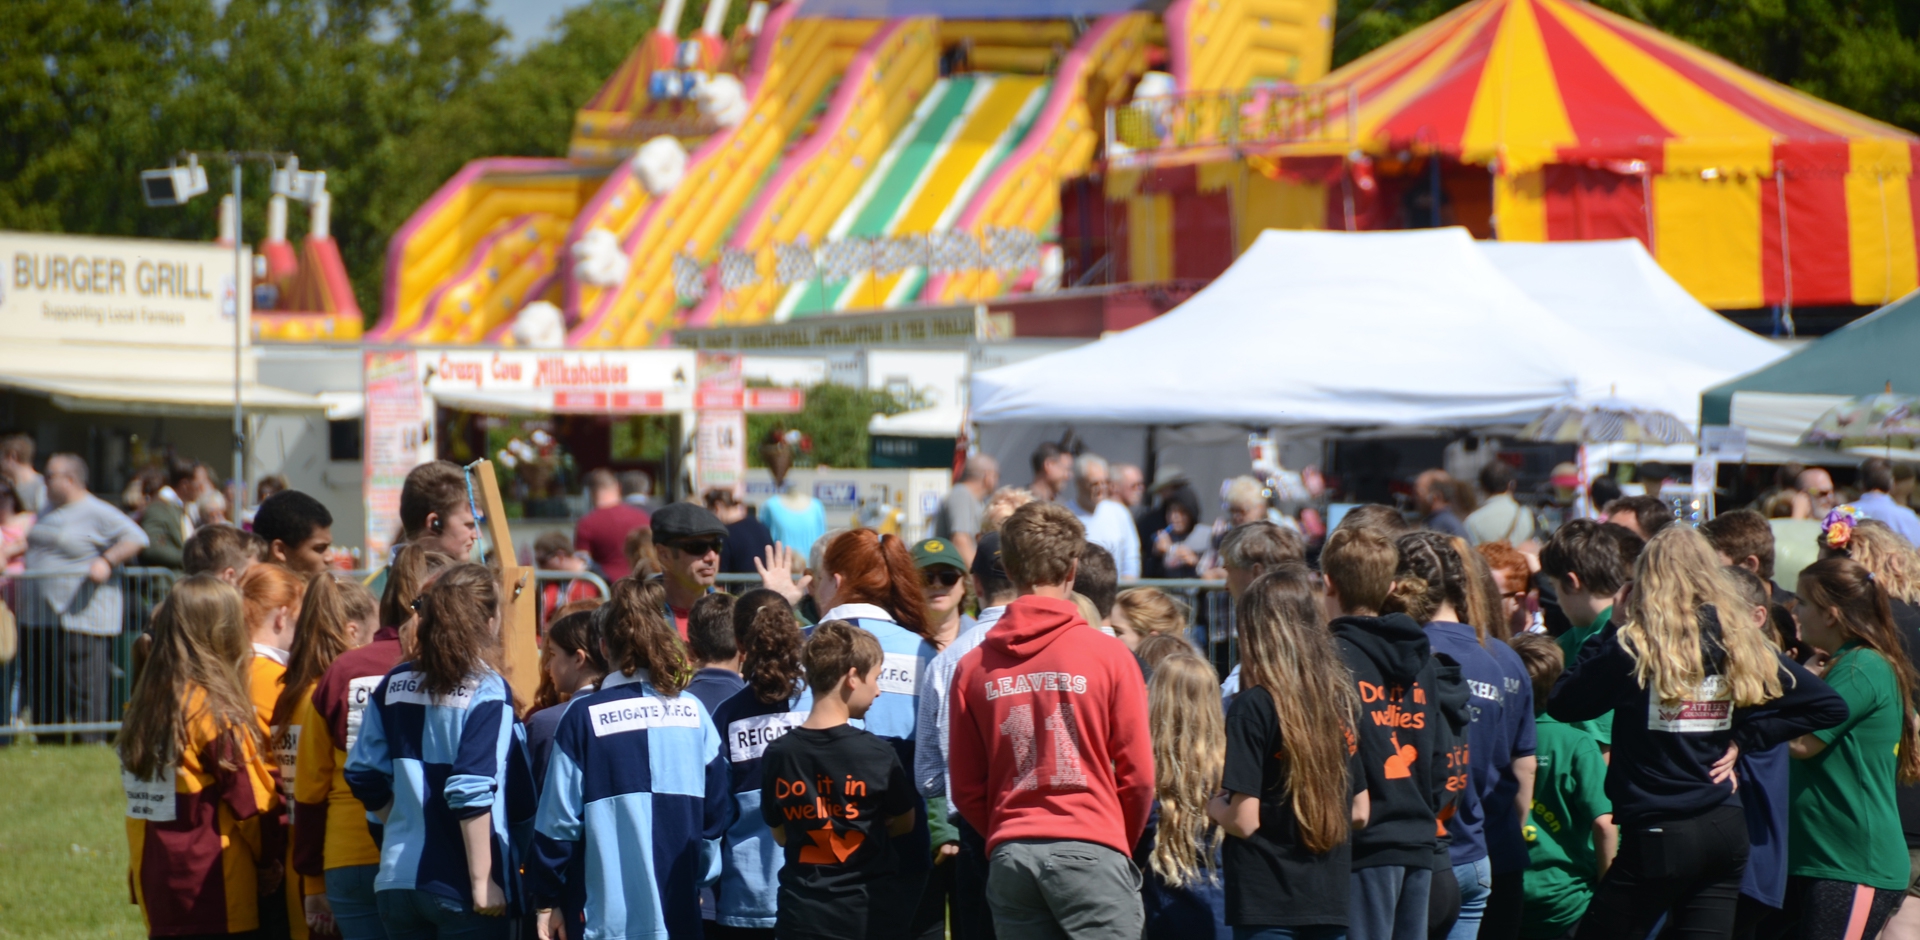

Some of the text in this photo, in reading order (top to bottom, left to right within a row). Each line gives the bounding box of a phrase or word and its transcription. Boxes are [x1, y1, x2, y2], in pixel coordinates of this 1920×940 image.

[14, 252, 212, 300] BURGER GRILL
[439, 352, 483, 388] Crazy
[491, 352, 522, 381] Cow
[533, 356, 628, 387] Milkshakes
[985, 672, 1087, 701] LEAVERS
[600, 704, 697, 726] REIGATE Y.F.C.
[999, 703, 1087, 790] 11
[775, 774, 867, 798] Do it in
[783, 796, 860, 820] wellies
